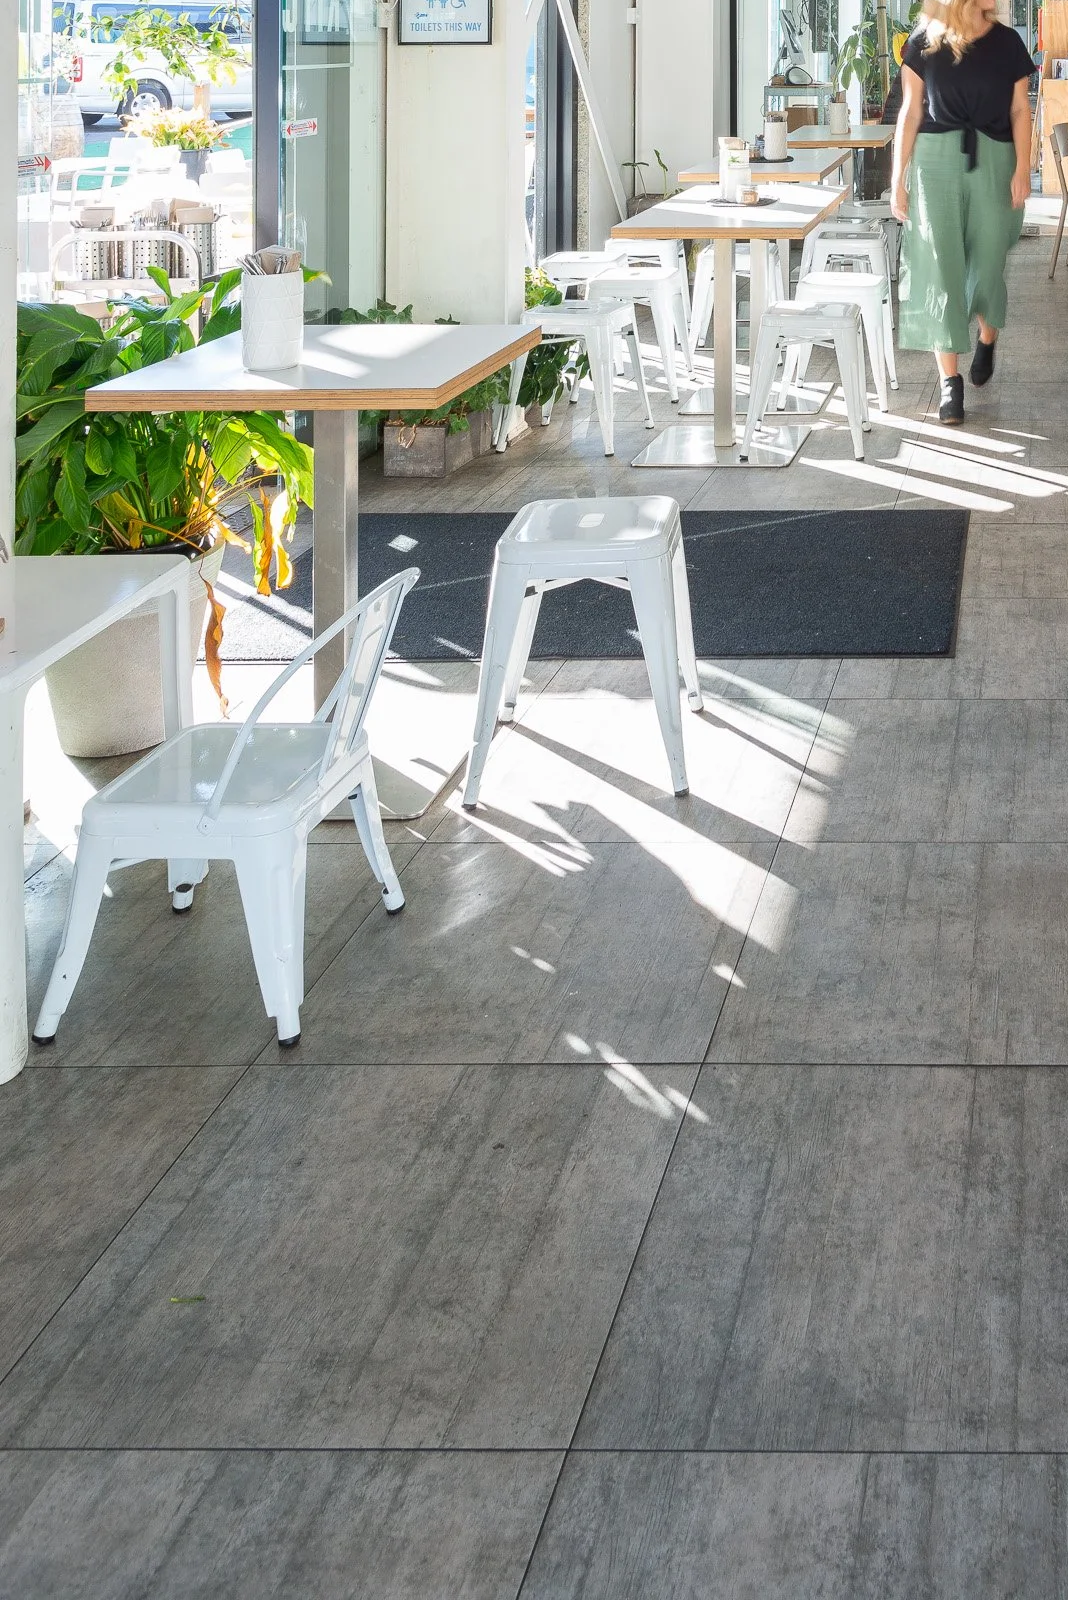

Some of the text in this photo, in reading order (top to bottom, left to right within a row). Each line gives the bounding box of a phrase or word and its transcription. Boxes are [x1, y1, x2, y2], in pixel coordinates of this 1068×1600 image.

[410, 22, 482, 32] TOILETS THIS WAY
